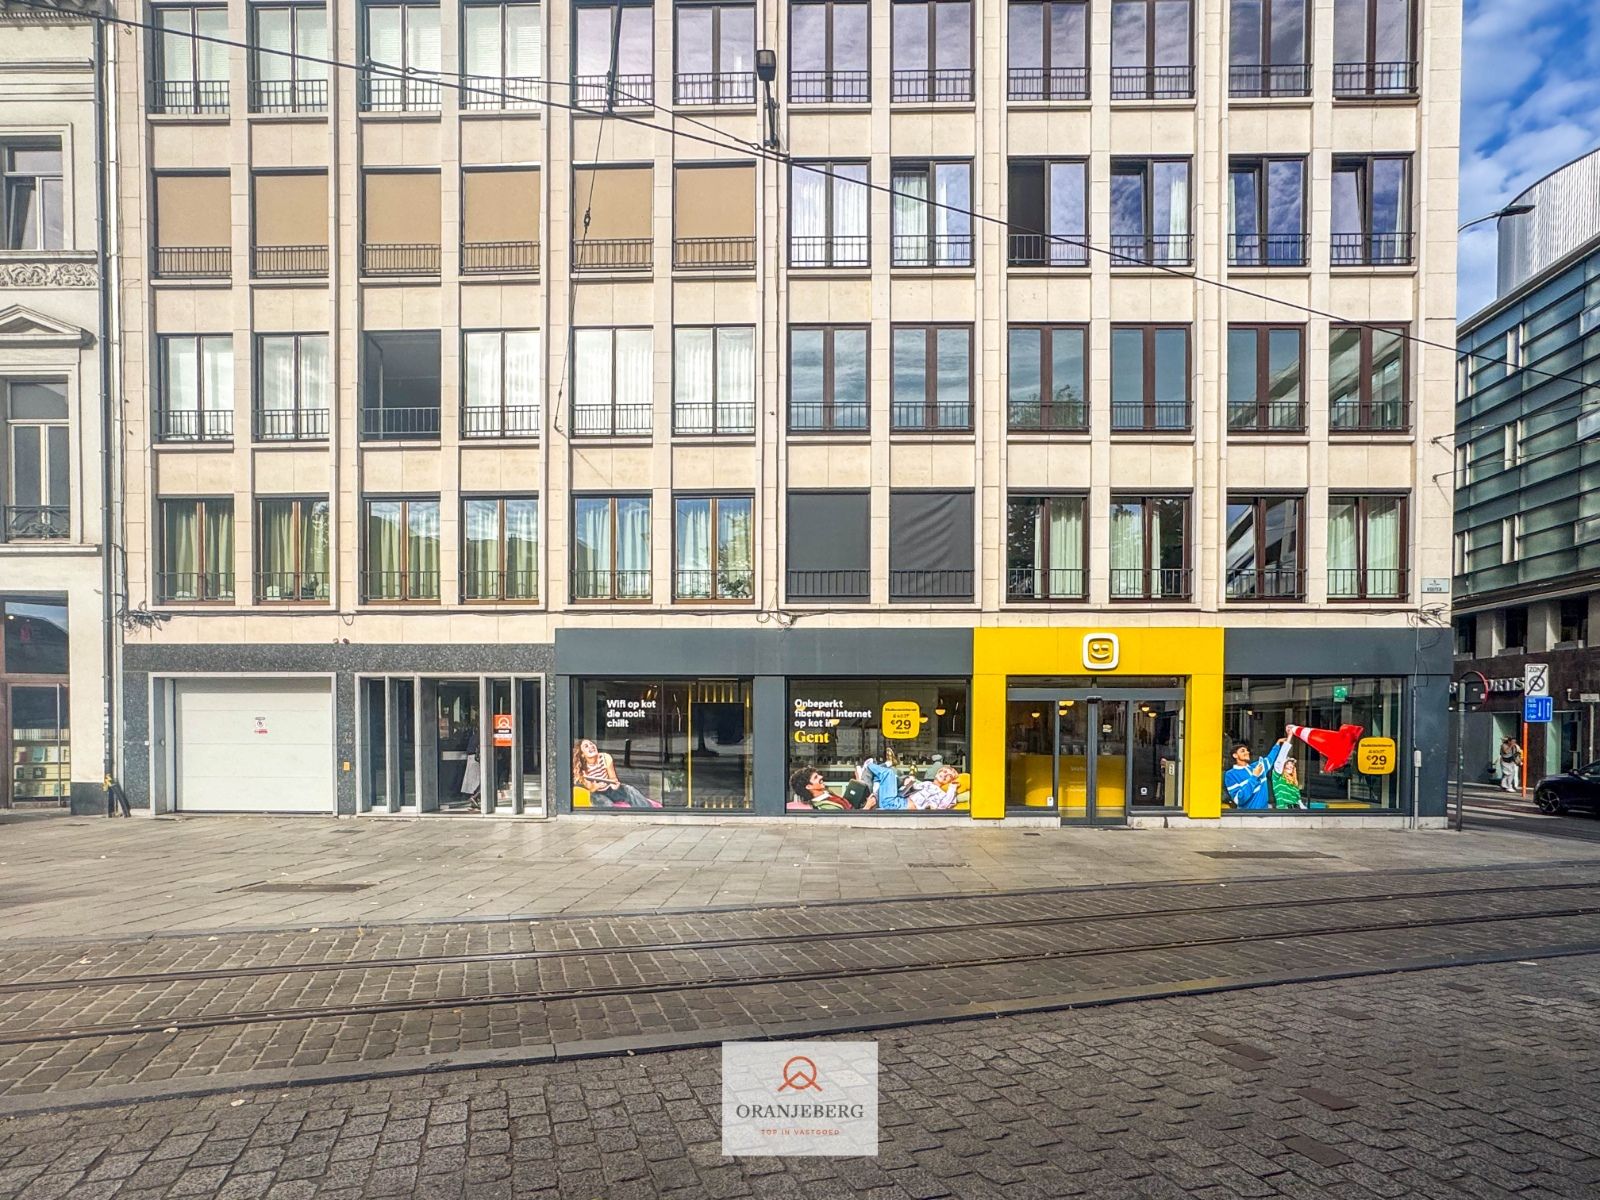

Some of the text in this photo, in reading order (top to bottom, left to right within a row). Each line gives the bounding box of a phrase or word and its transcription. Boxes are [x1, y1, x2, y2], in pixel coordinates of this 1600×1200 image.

[606, 699, 656, 710] Wifi op kot
[794, 699, 844, 709] Onbeperkt
[606, 709, 645, 718] die nooit
[794, 709, 872, 718] fibersnel internet
[606, 719, 629, 727] chillt
[794, 719, 834, 728] op kot in
[890, 719, 912, 730] €29
[794, 730, 830, 743] Gent
[1366, 755, 1387, 766] €29
